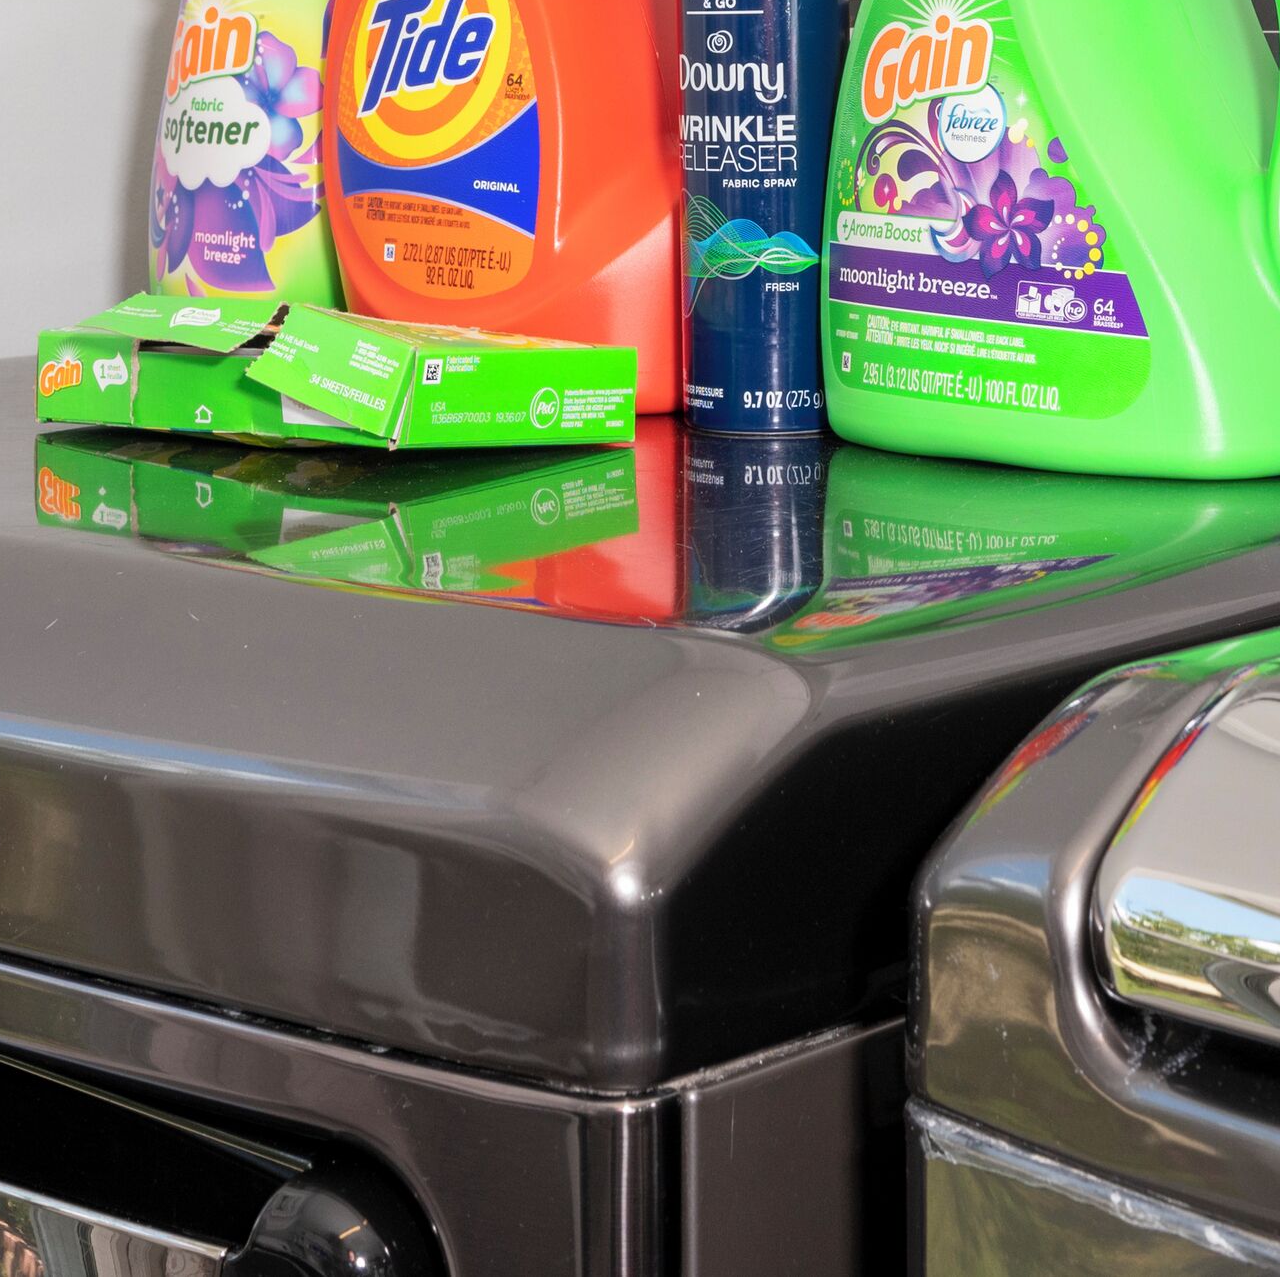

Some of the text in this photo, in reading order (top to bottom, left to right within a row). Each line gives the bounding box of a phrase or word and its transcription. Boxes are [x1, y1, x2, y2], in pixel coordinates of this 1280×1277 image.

[862, 14, 991, 121] Gain
[507, 73, 522, 87] 64
[679, 54, 784, 104] Downy
[191, 97, 224, 112] fabric
[679, 115, 796, 142] WRINKLE
[945, 104, 998, 133] febreze
[164, 110, 259, 154] softener
[951, 132, 986, 143] freshness
[473, 180, 520, 193] ORIGINAL
[723, 178, 797, 188] FABRIC SPRAY
[195, 230, 256, 252] moonlight
[445, 246, 456, 266] US
[426, 266, 436, 285] 92
[437, 267, 446, 286] FL
[448, 268, 458, 287] OZ
[840, 265, 915, 294] moonlight
[765, 283, 799, 292] FRESH
[1094, 299, 1114, 315] 64
[39, 360, 82, 396] Gain
[908, 367, 920, 392] US
[986, 379, 1004, 403] 100
[1006, 381, 1019, 406] FL
[1022, 384, 1038, 408] OZ
[309, 374, 386, 411] 34 SHEETS/FEUILLES
[696, 386, 724, 398] PRESSURE
[744, 391, 763, 408] 9.7
[766, 391, 783, 408] OZ
[786, 390, 810, 410] (275
[431, 402, 446, 412] USA
[536, 401, 556, 415] P&G
